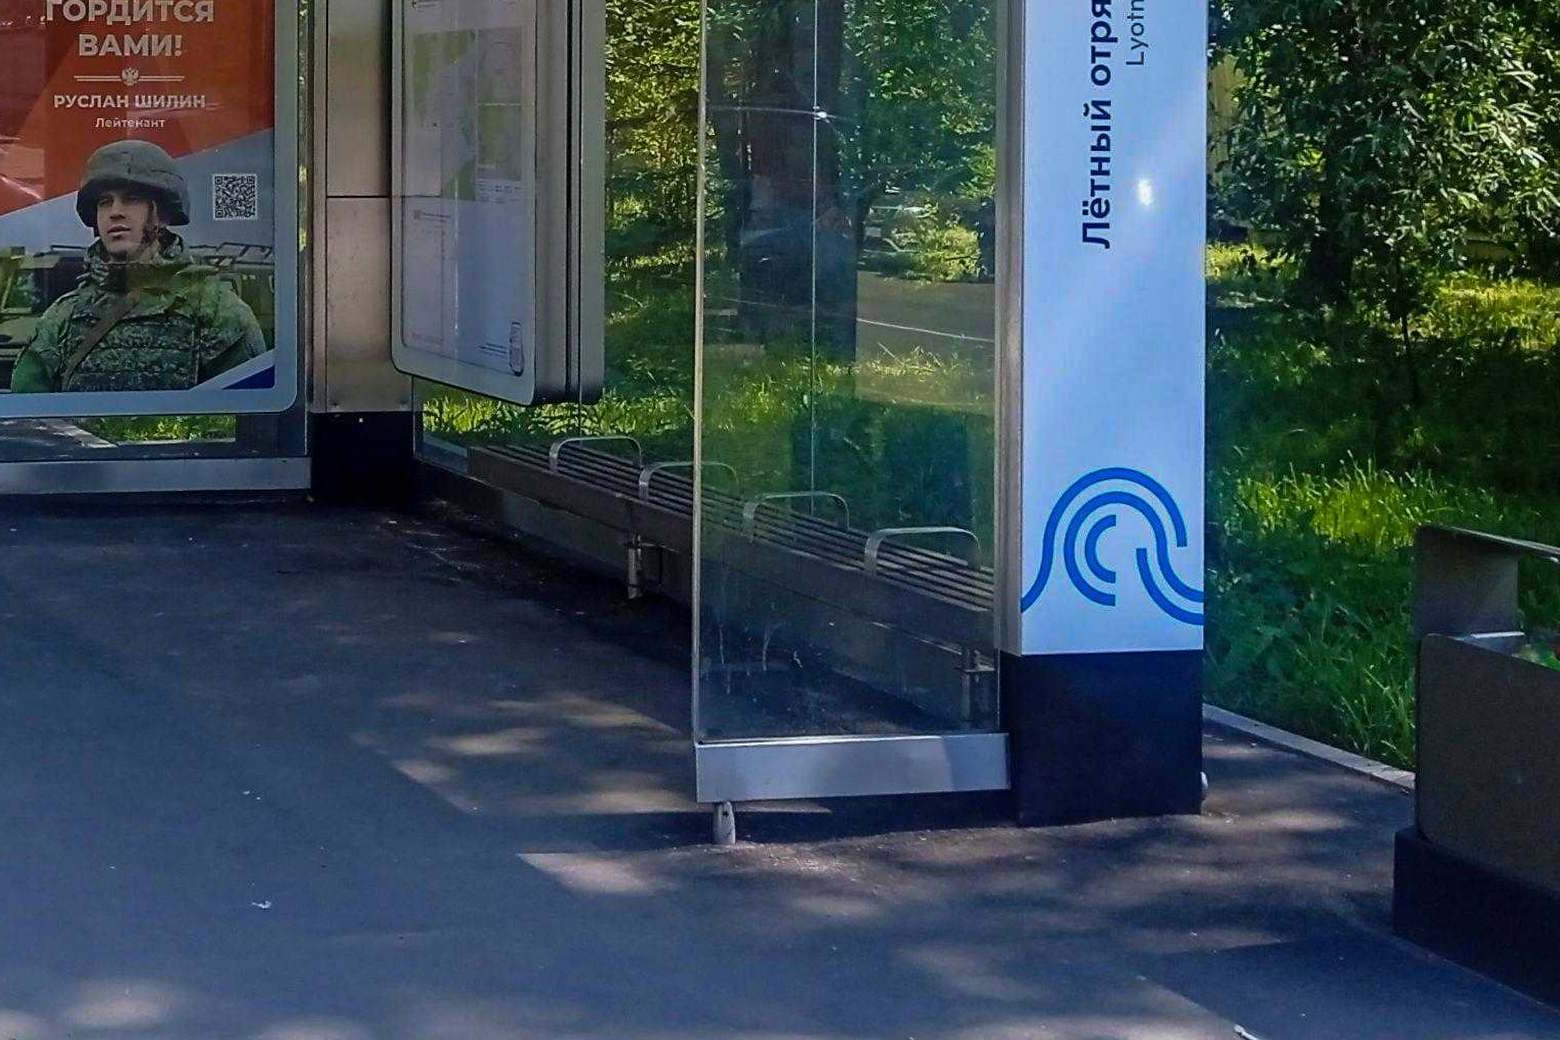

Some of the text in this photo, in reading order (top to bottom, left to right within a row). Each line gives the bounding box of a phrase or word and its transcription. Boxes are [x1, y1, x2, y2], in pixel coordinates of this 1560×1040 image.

[78, 33, 183, 58] ВАМИ!
[53, 93, 207, 110] РУСЛАН ШИЛИН
[95, 116, 166, 130] Лейтенант
[1082, 103, 1112, 250] Лётный
